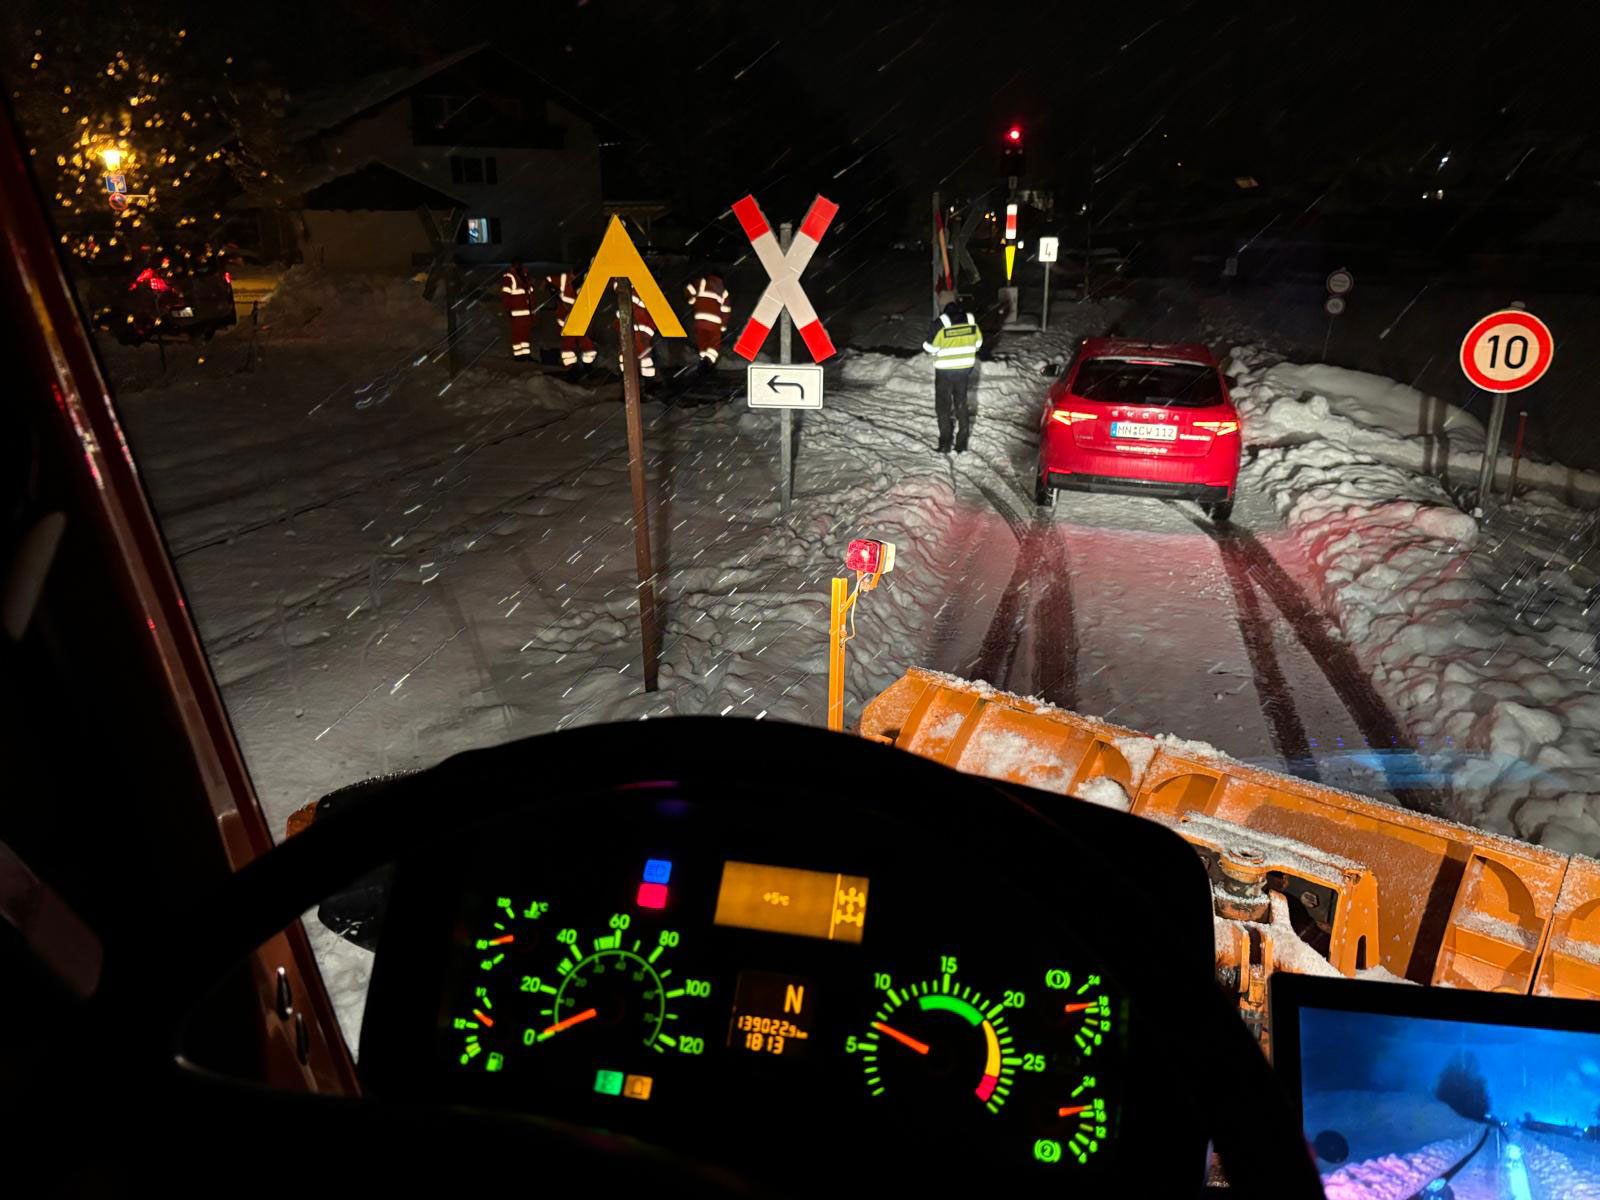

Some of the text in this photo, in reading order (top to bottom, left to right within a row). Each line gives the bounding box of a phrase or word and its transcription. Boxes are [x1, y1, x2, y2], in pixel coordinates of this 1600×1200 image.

[1487, 334, 1529, 370] 10
[610, 914, 630, 931] 60
[557, 929, 577, 945] 40
[658, 931, 679, 947] 80
[941, 956, 957, 975] 15
[521, 976, 541, 992] 20
[684, 980, 710, 997] 100
[875, 973, 892, 991] 10
[784, 985, 804, 1014] N
[1003, 991, 1024, 1008] 20
[524, 1029, 535, 1045] 0
[680, 1036, 703, 1054] 120
[846, 1036, 857, 1052] 5
[1022, 1053, 1045, 1072] 25
